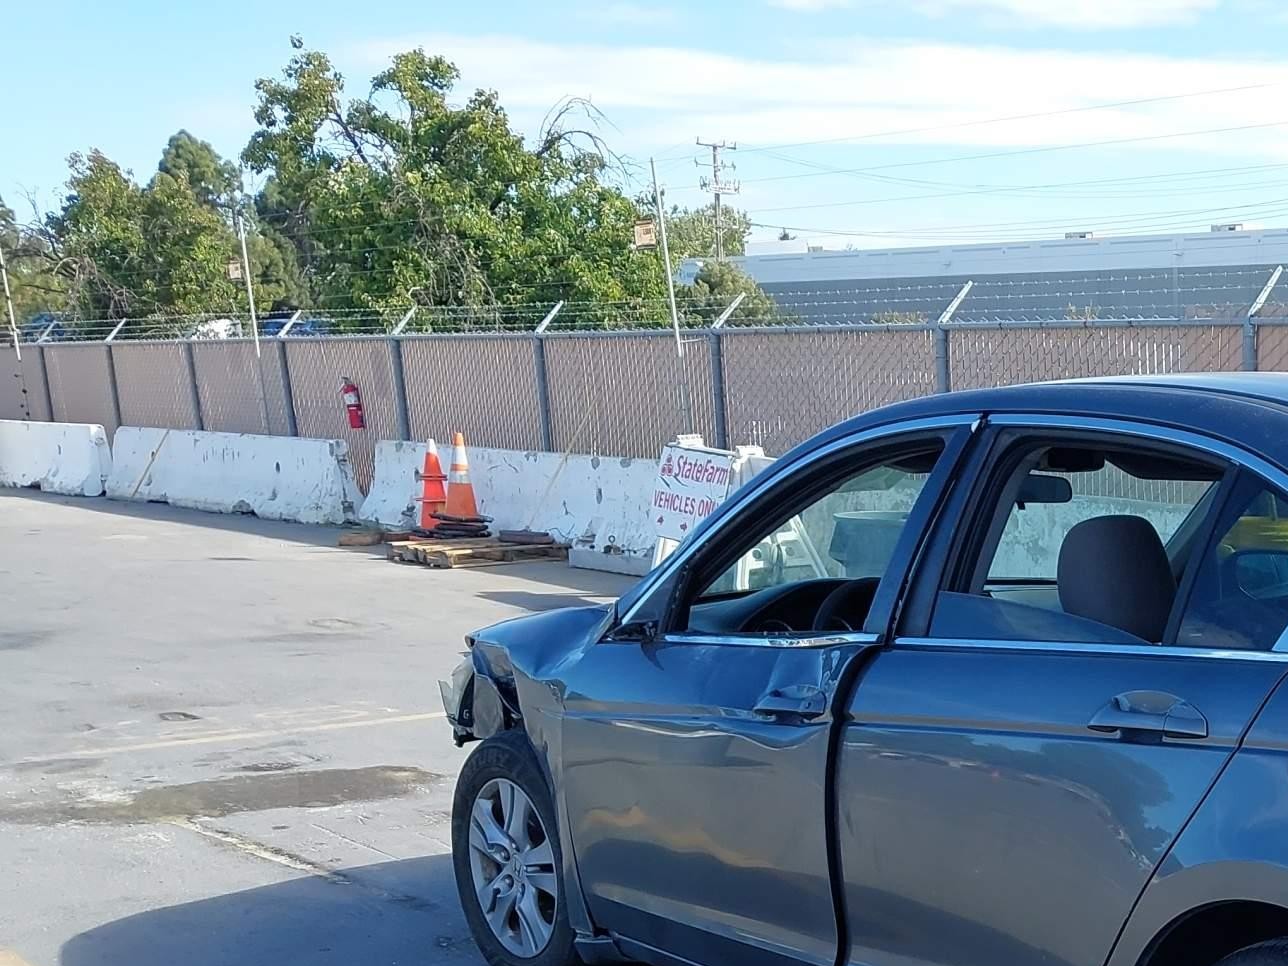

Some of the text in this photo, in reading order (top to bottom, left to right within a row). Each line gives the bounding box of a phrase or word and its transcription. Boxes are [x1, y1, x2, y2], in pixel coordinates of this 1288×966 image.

[674, 455, 728, 486] StateFarm
[654, 489, 719, 518] VEHICLES ON
